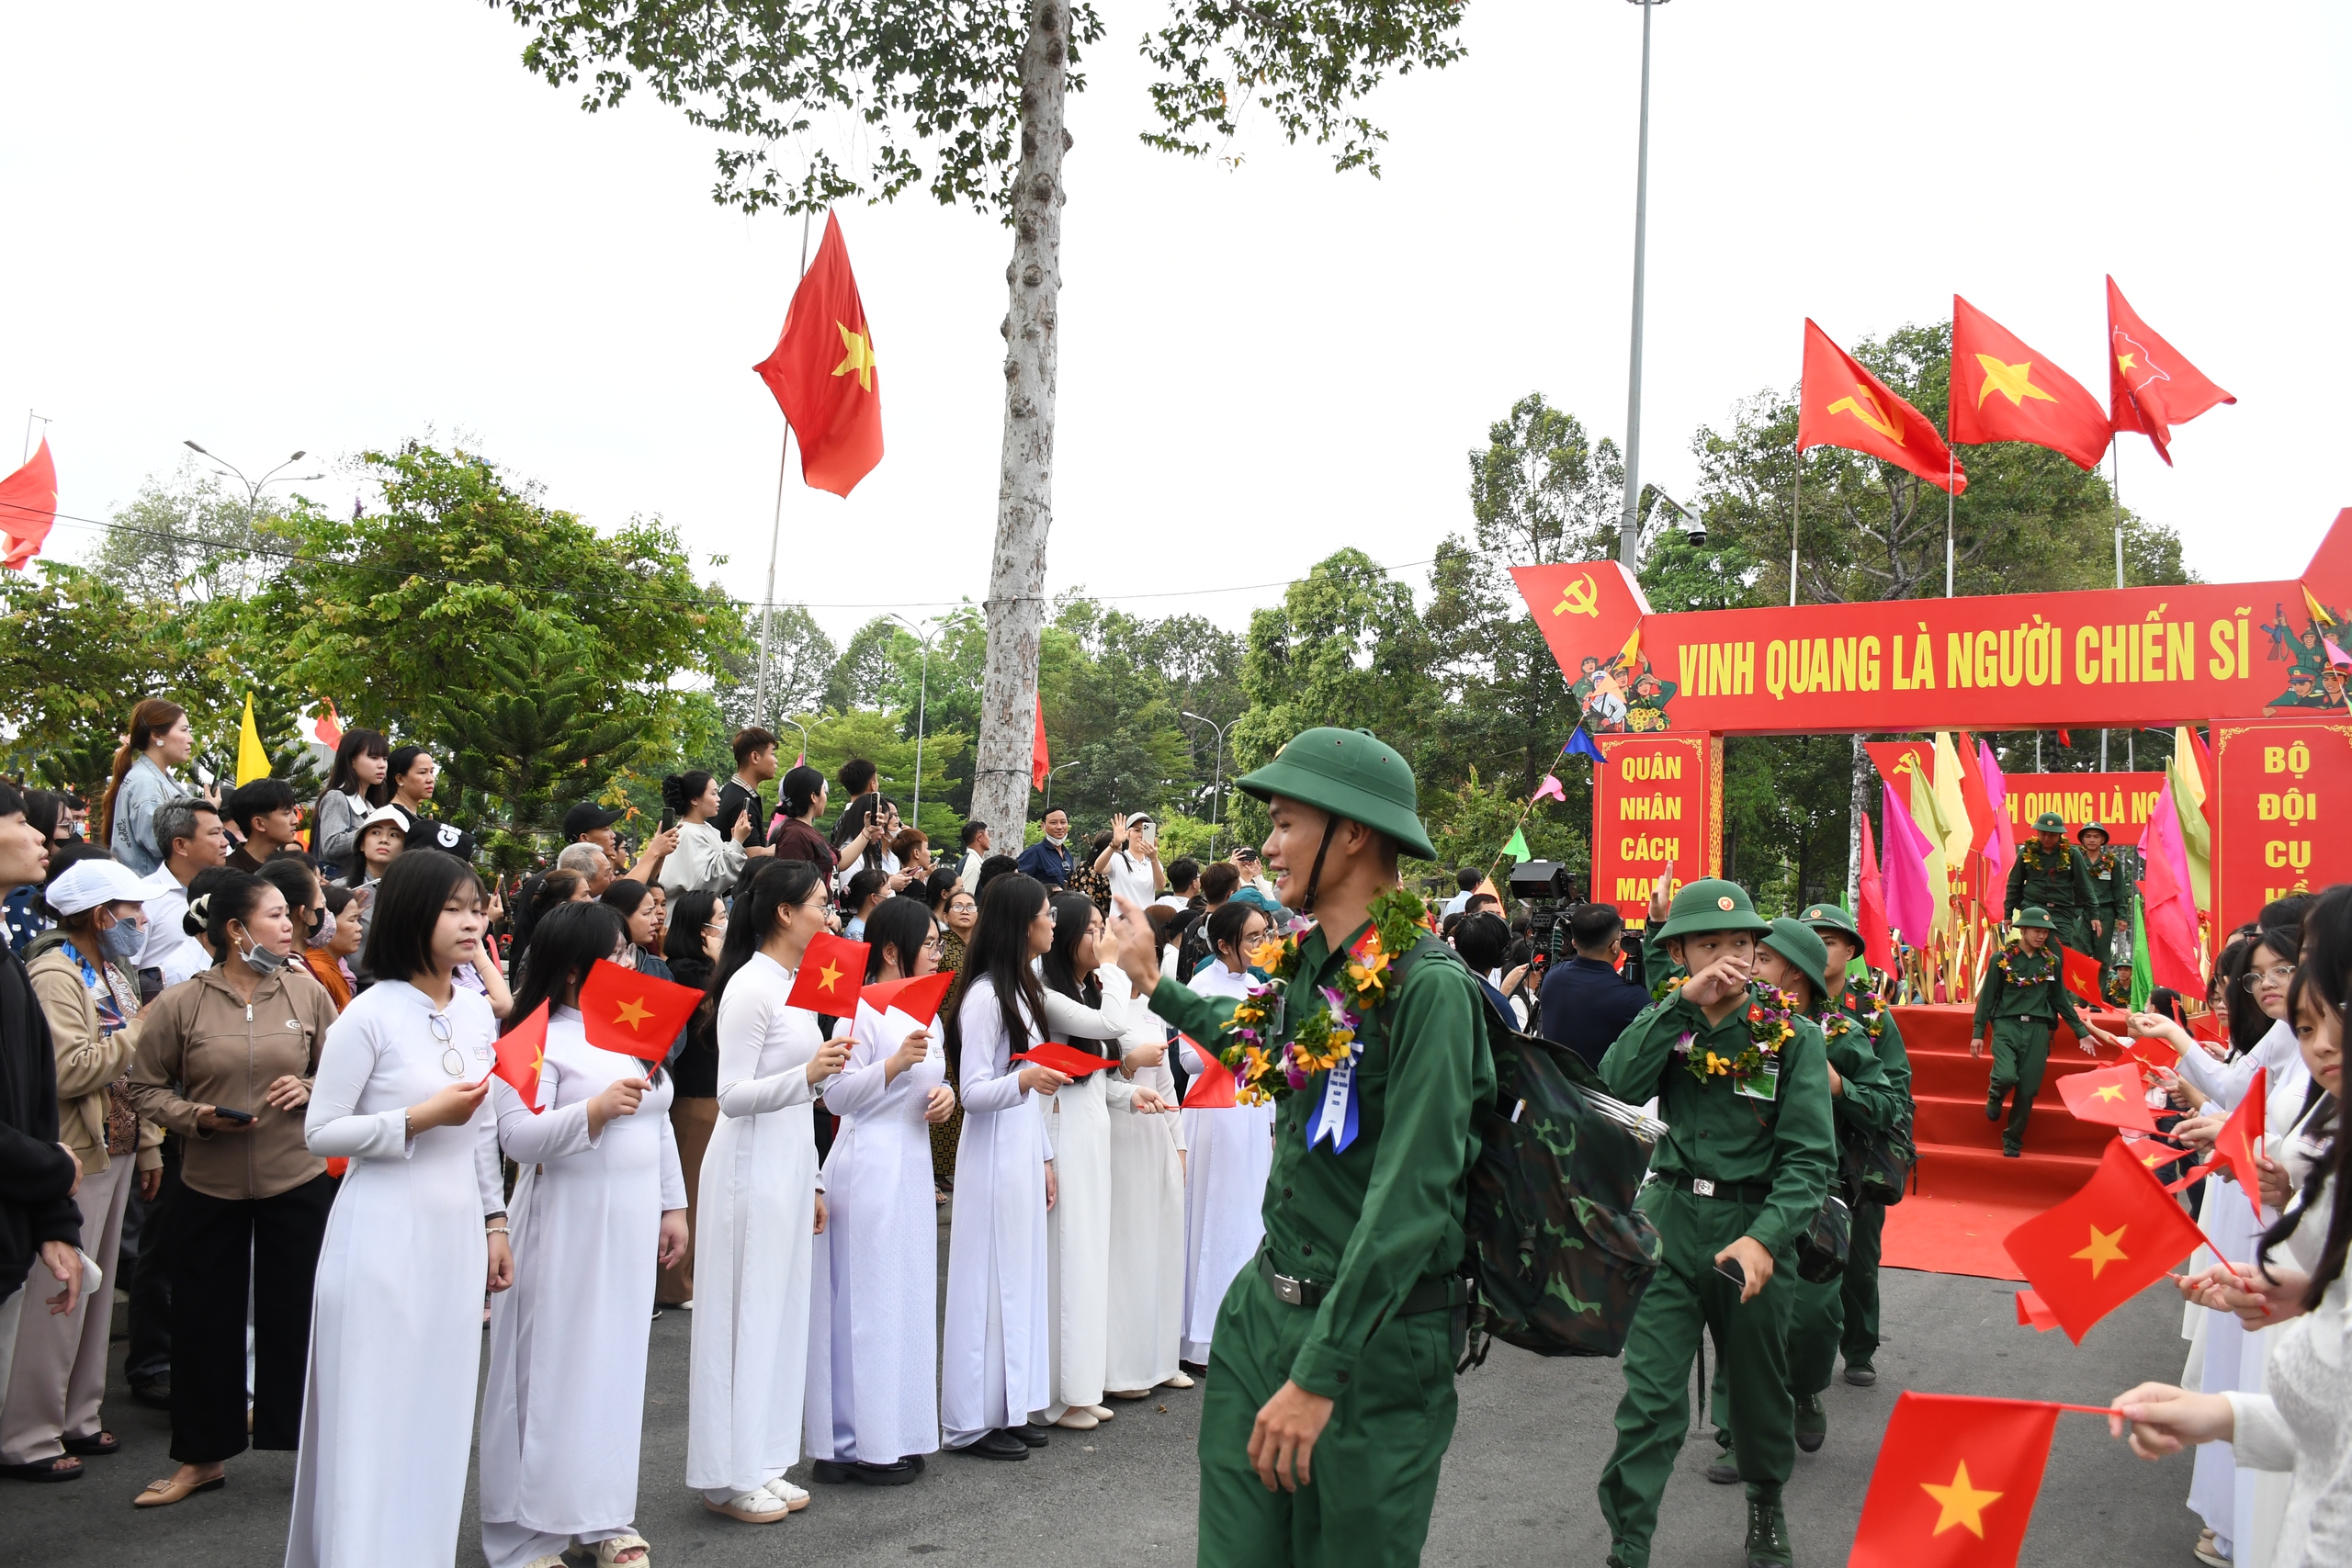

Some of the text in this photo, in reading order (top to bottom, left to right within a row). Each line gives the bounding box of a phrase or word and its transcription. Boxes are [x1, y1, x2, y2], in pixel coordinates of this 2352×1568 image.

[1679, 603, 2252, 700] VINH QUANG LÀ NGƯỜI CHIẾN SĨ
[1622, 751, 1681, 784] QUÂN
[2264, 739, 2310, 779] BỘ
[1620, 792, 1681, 820] NHÂN
[2024, 792, 2093, 826] QUANG
[2099, 785, 2125, 824] LÀ
[2257, 787, 2316, 827] ĐỘI
[1620, 832, 1679, 862] CÁCH
[2265, 840, 2311, 874] CỤ
